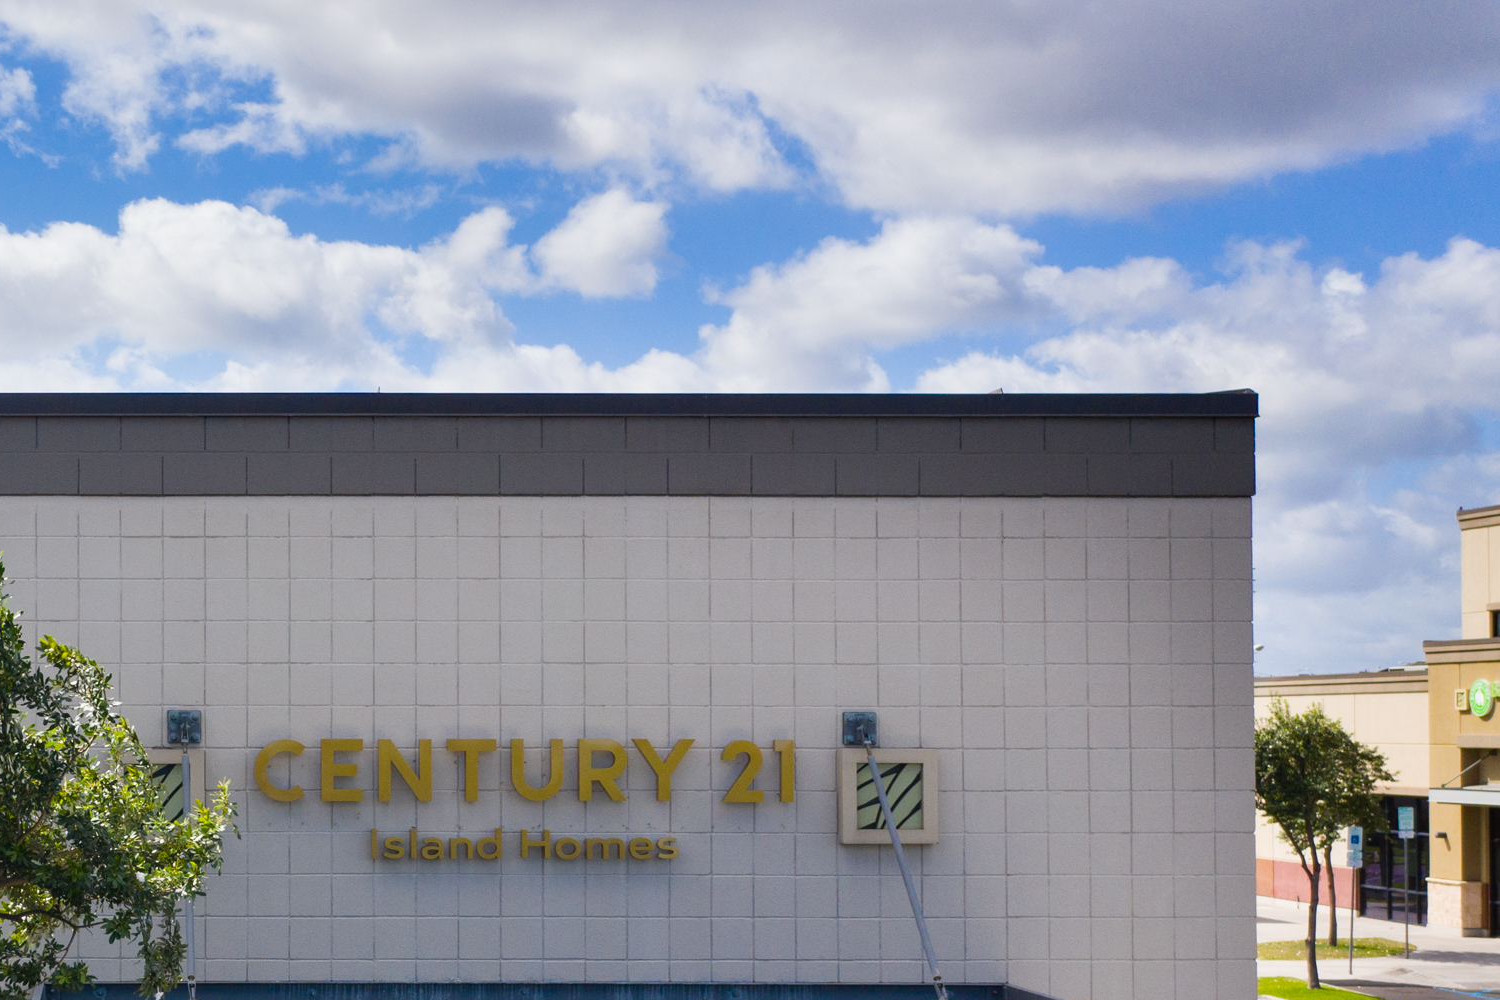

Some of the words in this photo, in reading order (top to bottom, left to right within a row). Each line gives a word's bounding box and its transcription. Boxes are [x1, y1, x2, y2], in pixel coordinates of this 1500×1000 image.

[254, 738, 695, 803] CENTURY
[720, 739, 795, 803] 21
[372, 829, 501, 859] Island
[522, 830, 677, 859] Homes
